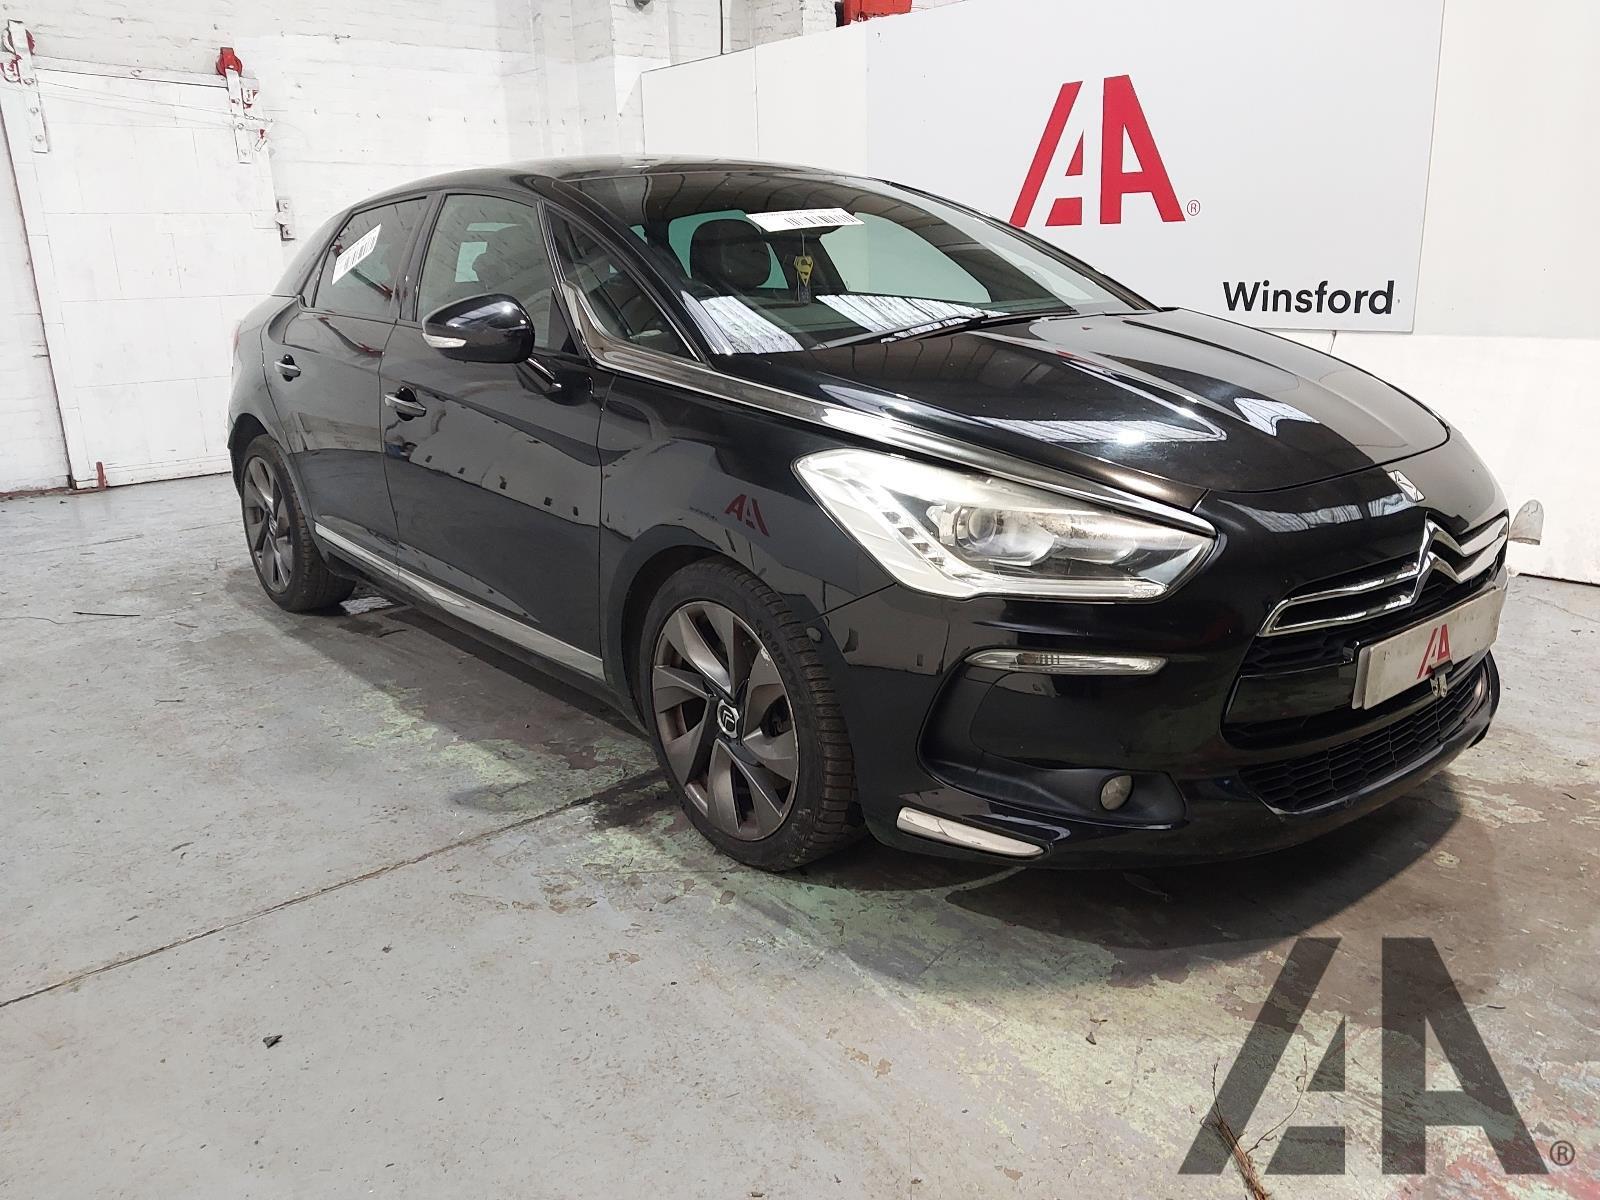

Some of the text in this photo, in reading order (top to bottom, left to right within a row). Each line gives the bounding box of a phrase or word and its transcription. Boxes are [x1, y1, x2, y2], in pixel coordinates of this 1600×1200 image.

[1009, 74, 1186, 227] AA
[1223, 280, 1395, 314] Winsford
[1417, 623, 1451, 680] AA
